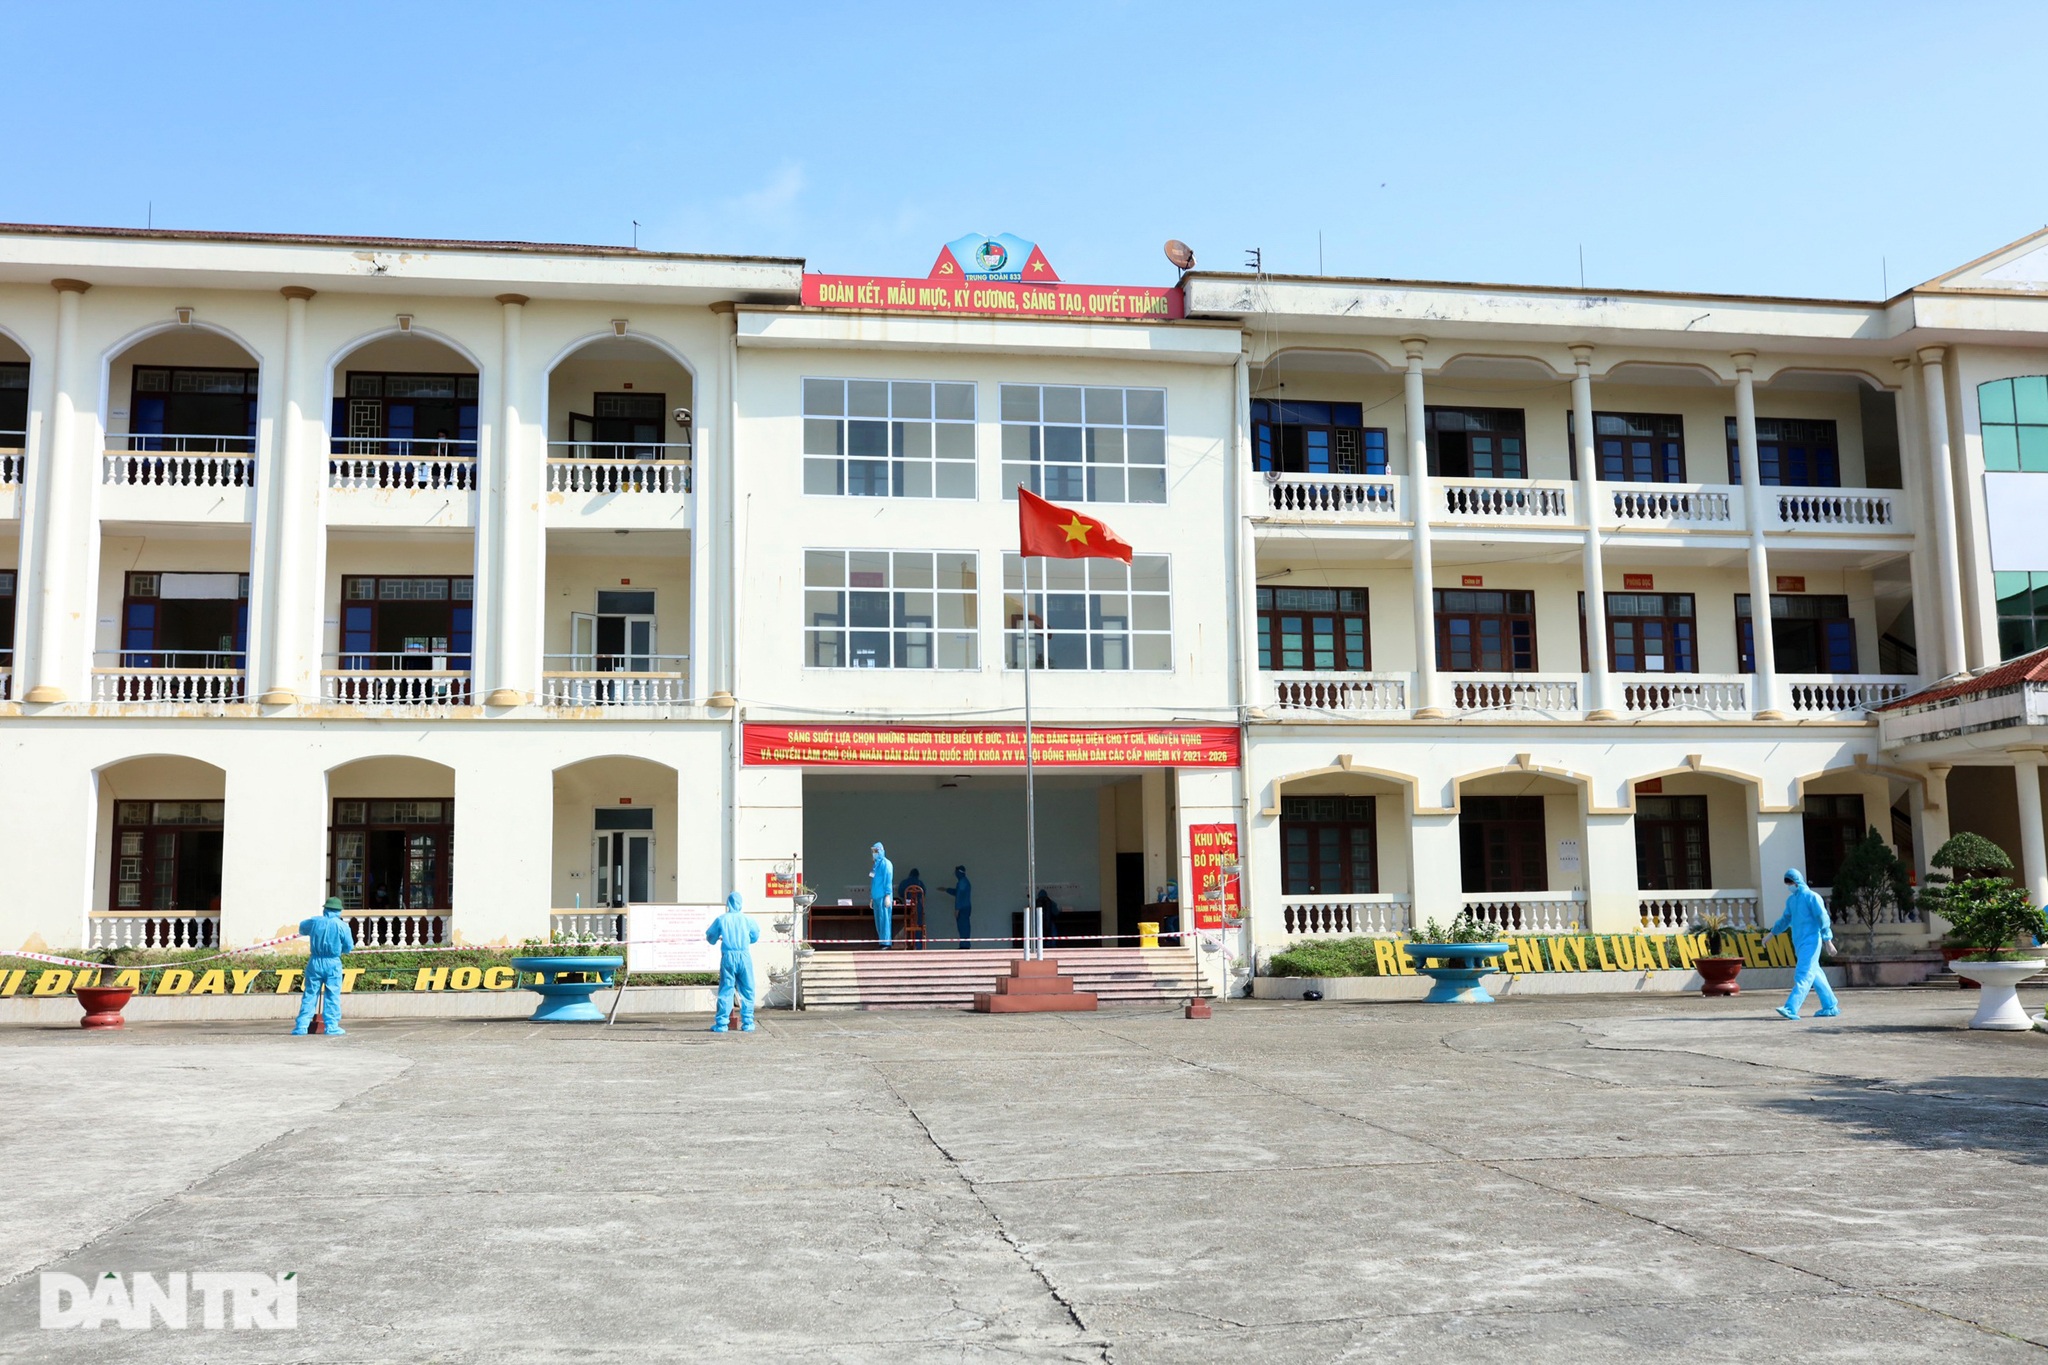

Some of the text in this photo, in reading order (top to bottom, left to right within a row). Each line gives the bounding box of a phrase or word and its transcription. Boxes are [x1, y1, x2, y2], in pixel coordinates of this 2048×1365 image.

[989, 272, 1008, 280] ĐOÀN
[819, 280, 1168, 315] ĐOÀN KẾT, MẪU MỰC, KỶ CƯƠNG, SÁNG TẠO, QUYẾT THẮNG
[788, 730, 810, 743] SÁNG
[813, 729, 833, 743] SUỐT
[835, 731, 851, 745] LỰA
[853, 731, 875, 746] CHỌN
[877, 730, 905, 744] NHỮNG
[907, 730, 932, 744] NGƯỜI
[934, 731, 952, 744] TIÊU
[953, 729, 972, 744] BIỂU
[985, 731, 1004, 745] ĐỨC,
[1006, 731, 1021, 745] TÀI,
[1046, 731, 1068, 744] ĐÁNG
[1070, 733, 1084, 746] ĐẠI
[1085, 732, 1104, 746] DIỆN
[1106, 733, 1122, 744] CHO
[1124, 732, 1129, 744] Ý
[1130, 732, 1146, 745] CHÍ,
[1148, 732, 1179, 747] NGUYỆN
[1180, 733, 1202, 747] VỌNG
[761, 746, 771, 760] VÀ
[802, 746, 820, 760] LÀM
[822, 746, 839, 760] CHỦ
[841, 746, 857, 760] CỦA
[859, 747, 882, 760] NHÂN
[884, 747, 901, 760] DÂN
[922, 747, 938, 760] VÀO
[940, 746, 961, 762] QUỐC
[963, 747, 977, 763] HỘI
[1002, 749, 1013, 760] XV
[1014, 747, 1025, 760] VÀ
[1030, 747, 1040, 763] ỘI
[1066, 747, 1088, 760] NHÂN
[1090, 747, 1106, 760] DÂN
[1108, 747, 1124, 760] CÁC
[1126, 746, 1142, 761] CẤP
[1144, 748, 1170, 763] NHIỆM
[1183, 750, 1201, 761] 2021
[1208, 751, 1228, 762] 2026
[1194, 831, 1233, 848] KHU VỰC
[1194, 849, 1206, 867] BỎ
[1203, 869, 1215, 887] SỐ
[1548, 921, 1588, 973] KỶ
[1595, 926, 1670, 978] LUẬT
[275, 968, 366, 994] TT
